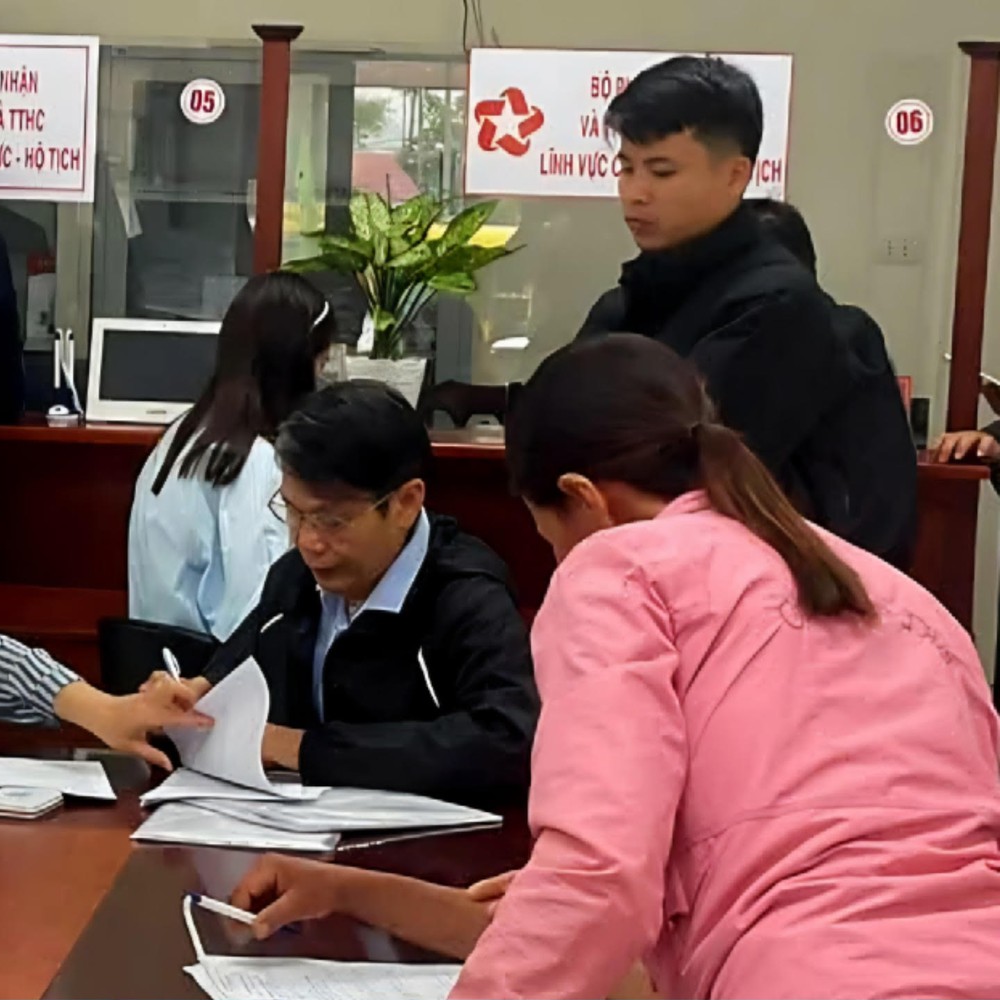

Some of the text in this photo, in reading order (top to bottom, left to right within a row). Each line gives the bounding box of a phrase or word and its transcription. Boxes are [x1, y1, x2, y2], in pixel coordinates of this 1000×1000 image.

[0, 65, 39, 97] NHẬN
[591, 70, 612, 101] BỘ
[189, 89, 215, 113] 05
[8, 108, 45, 131] TTHC
[580, 109, 600, 138] VÀ
[896, 109, 923, 134] 06
[24, 141, 45, 172] HỘ
[48, 147, 80, 173] TỊCH
[540, 147, 573, 176] LĨNH
[578, 153, 608, 180] VỰC
